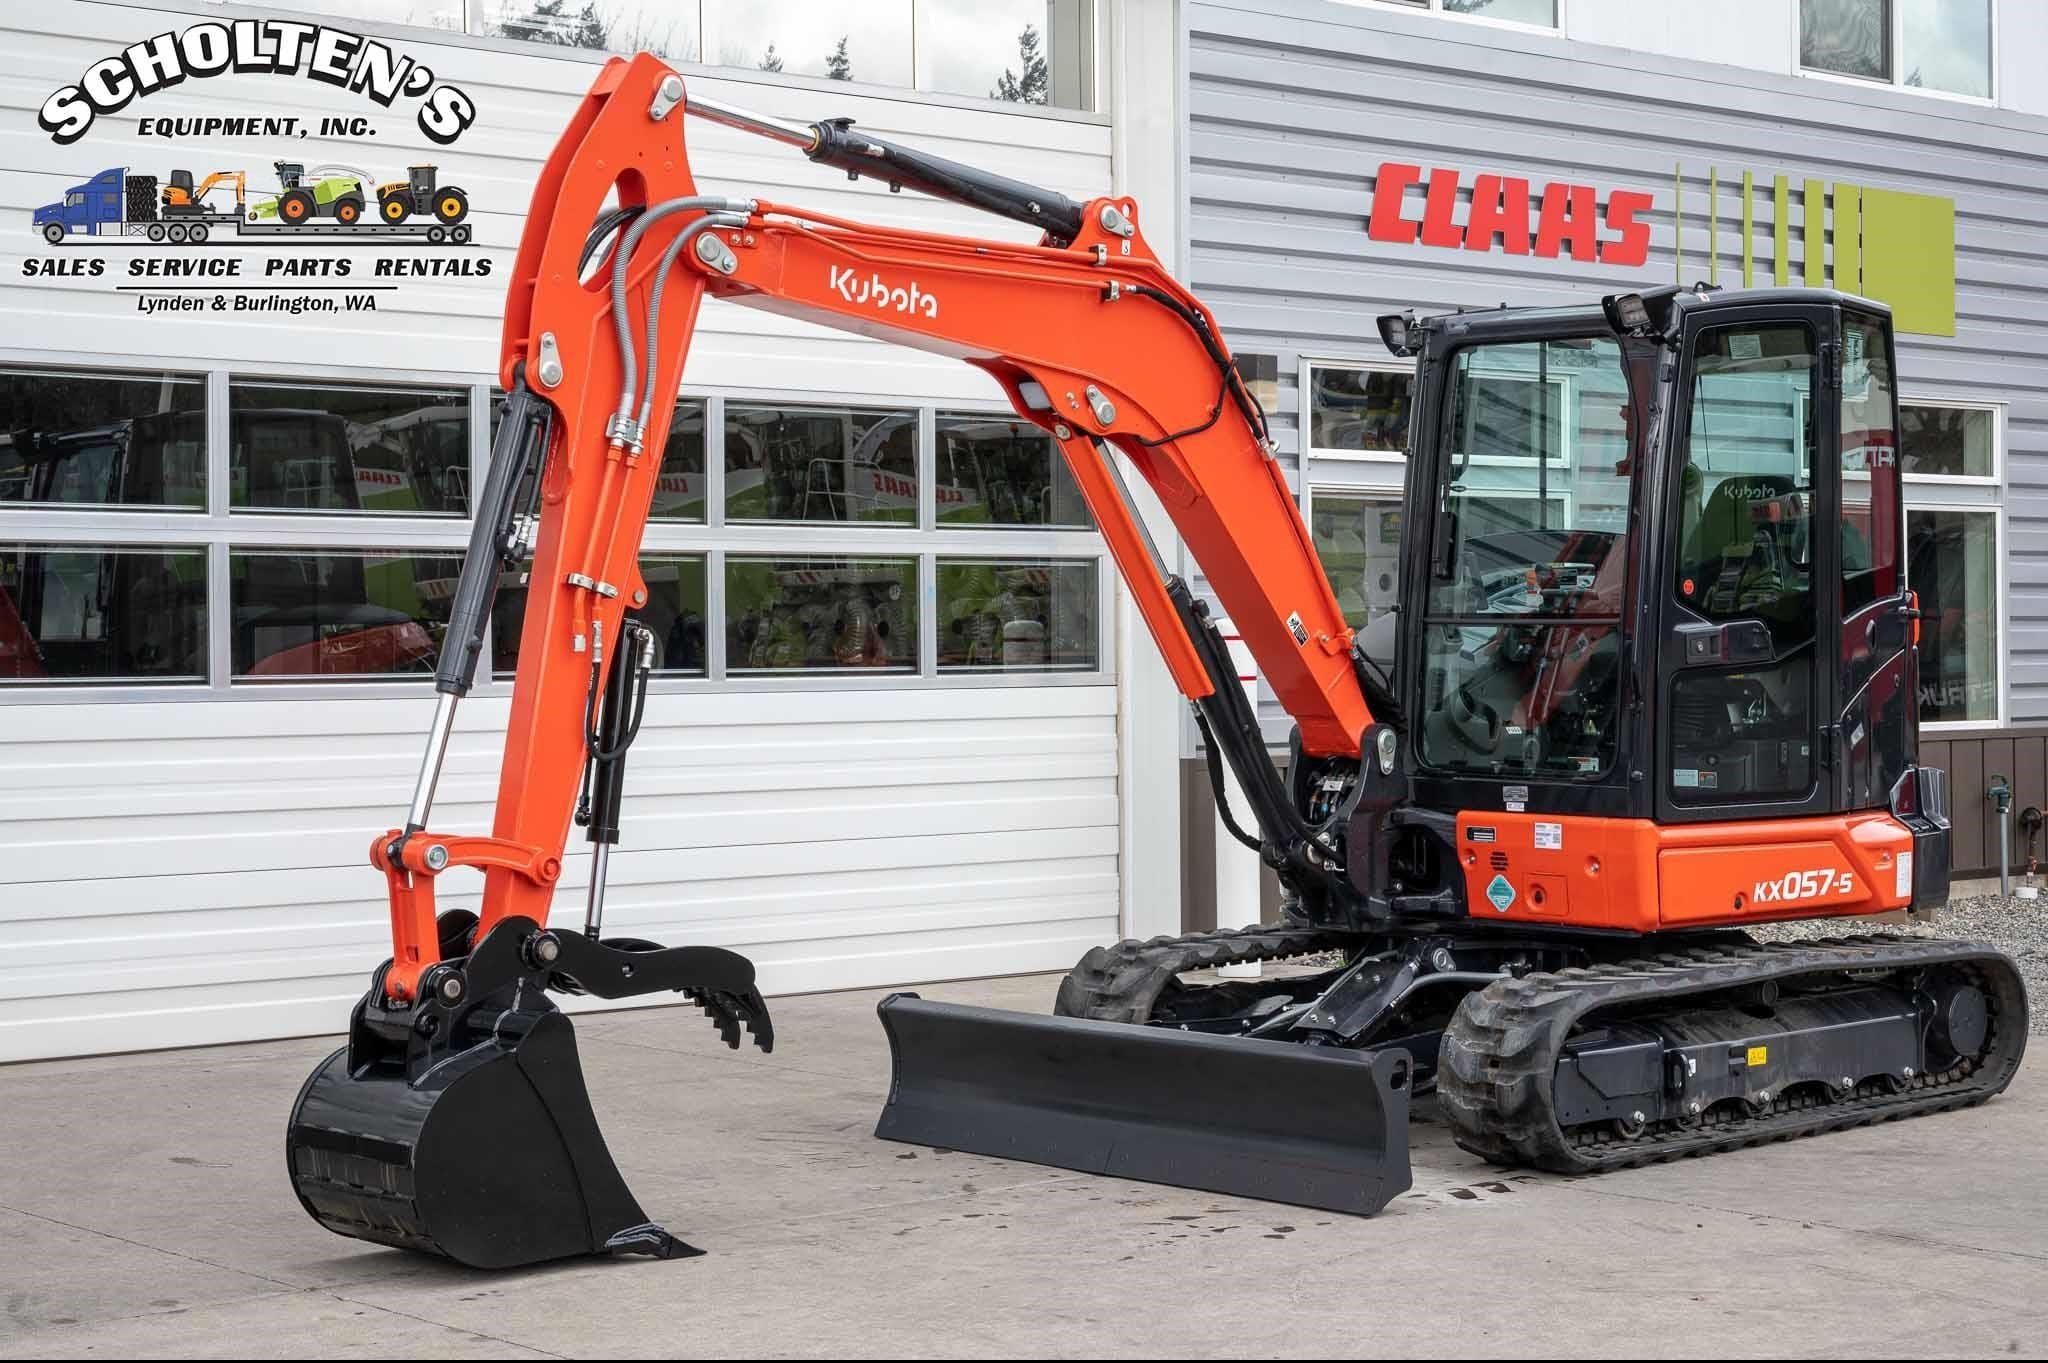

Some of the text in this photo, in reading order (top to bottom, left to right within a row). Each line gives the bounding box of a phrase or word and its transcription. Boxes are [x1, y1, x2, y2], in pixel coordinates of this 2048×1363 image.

[1368, 162, 1654, 267] CLAAS
[830, 264, 938, 318] Kubota
[1724, 483, 1776, 499] Kubota
[1753, 868, 1853, 903] KX057-5
